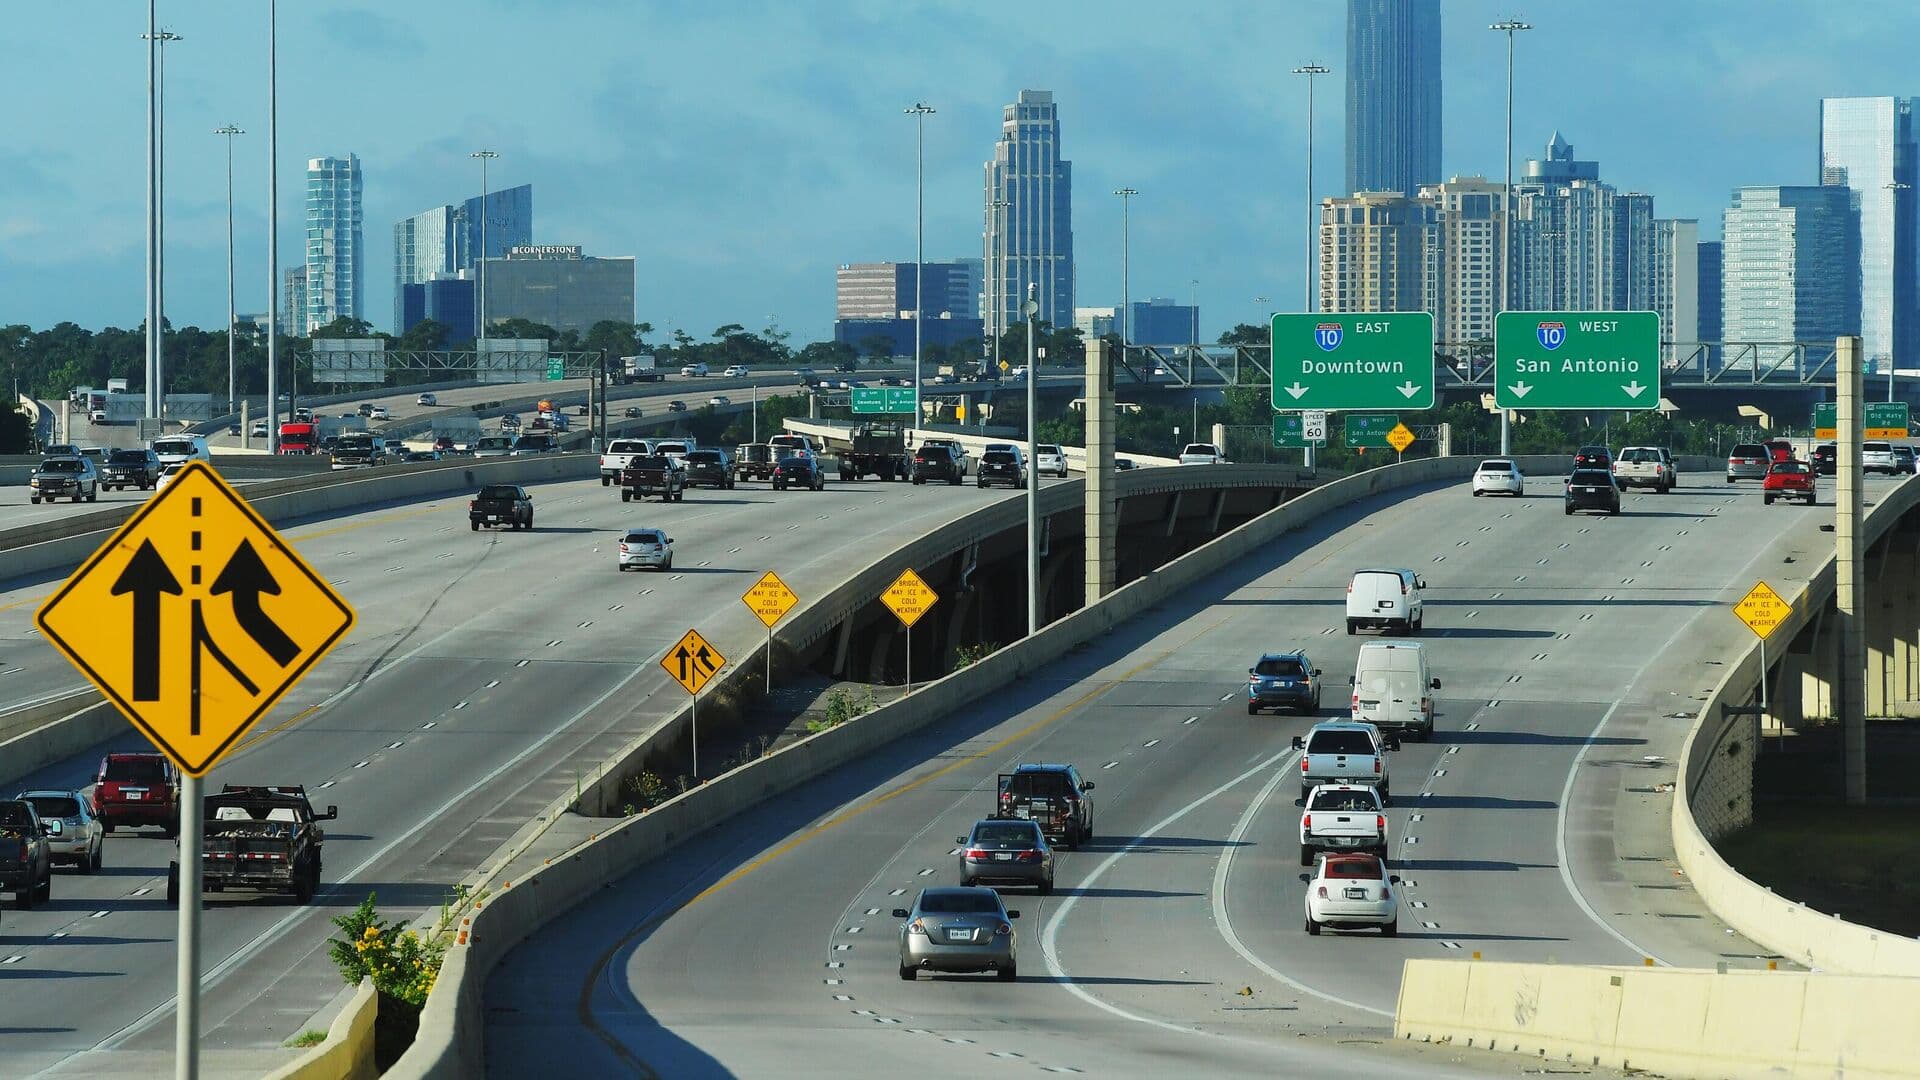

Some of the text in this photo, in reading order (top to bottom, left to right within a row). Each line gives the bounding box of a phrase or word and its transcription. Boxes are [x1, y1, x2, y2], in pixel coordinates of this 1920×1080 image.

[519, 246, 576, 254] CORNERSTONE
[1356, 322, 1390, 333] EAST
[1579, 321, 1618, 332] WEST
[1320, 330, 1338, 346] 10
[1543, 329, 1561, 344] 10
[1302, 360, 1403, 374] Downtown
[1516, 358, 1639, 373] San Antonio
[1307, 428, 1322, 437] 60
